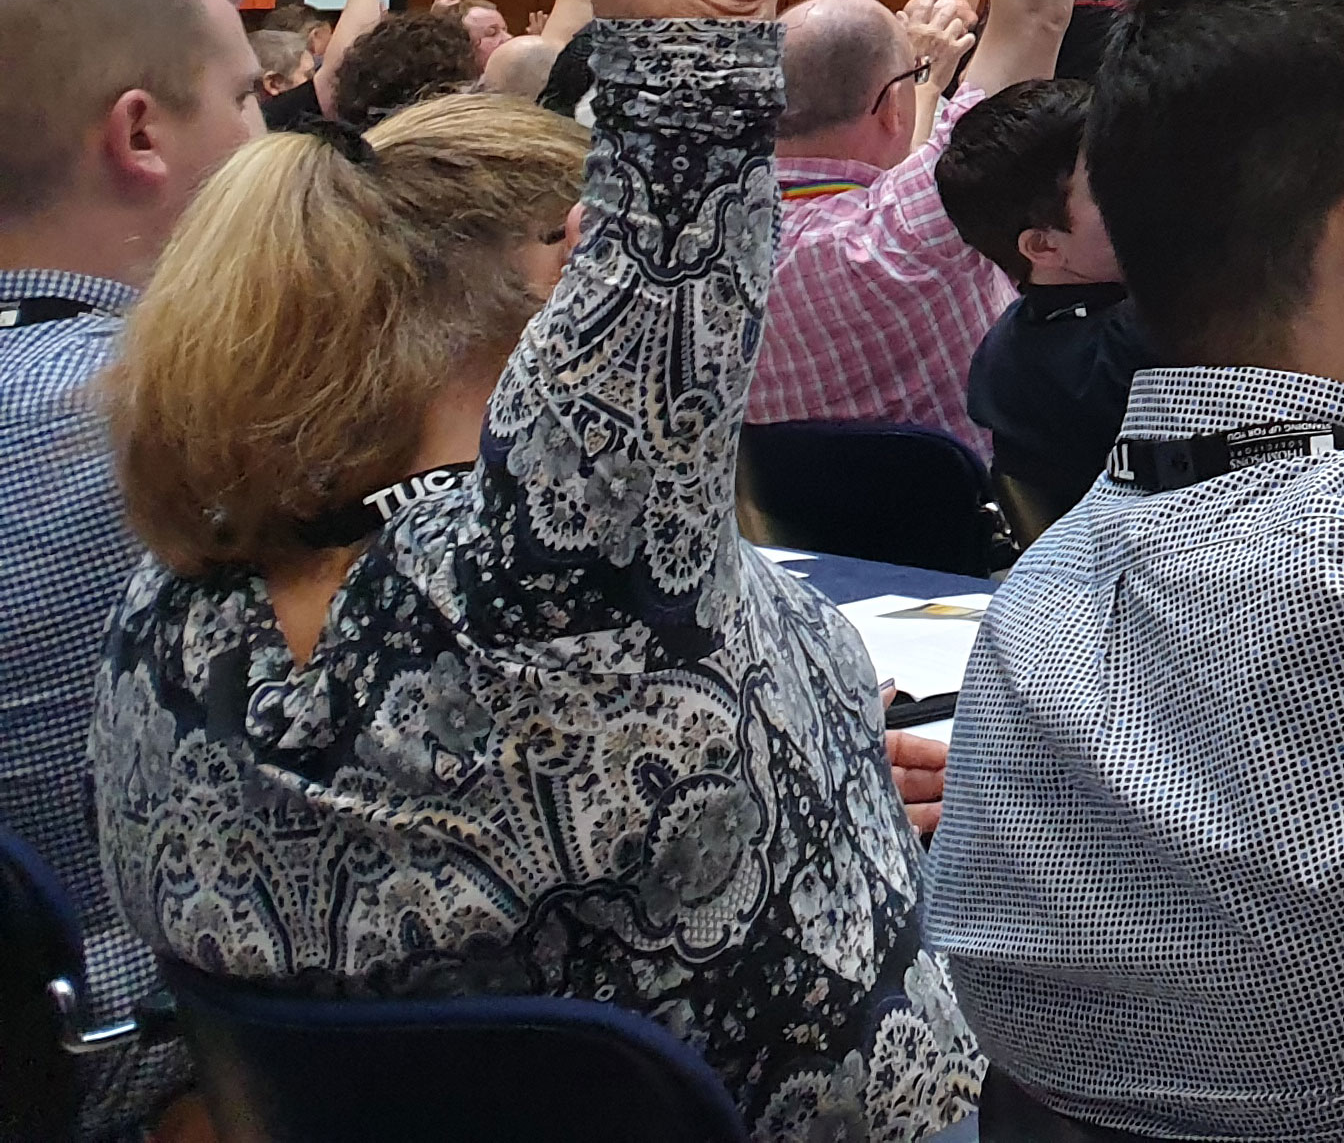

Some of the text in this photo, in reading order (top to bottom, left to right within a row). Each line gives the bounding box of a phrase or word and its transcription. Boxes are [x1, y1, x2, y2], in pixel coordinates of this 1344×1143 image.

[1227, 422, 1333, 442] STANDING UP FOR YOU
[363, 469, 456, 521] TUC
